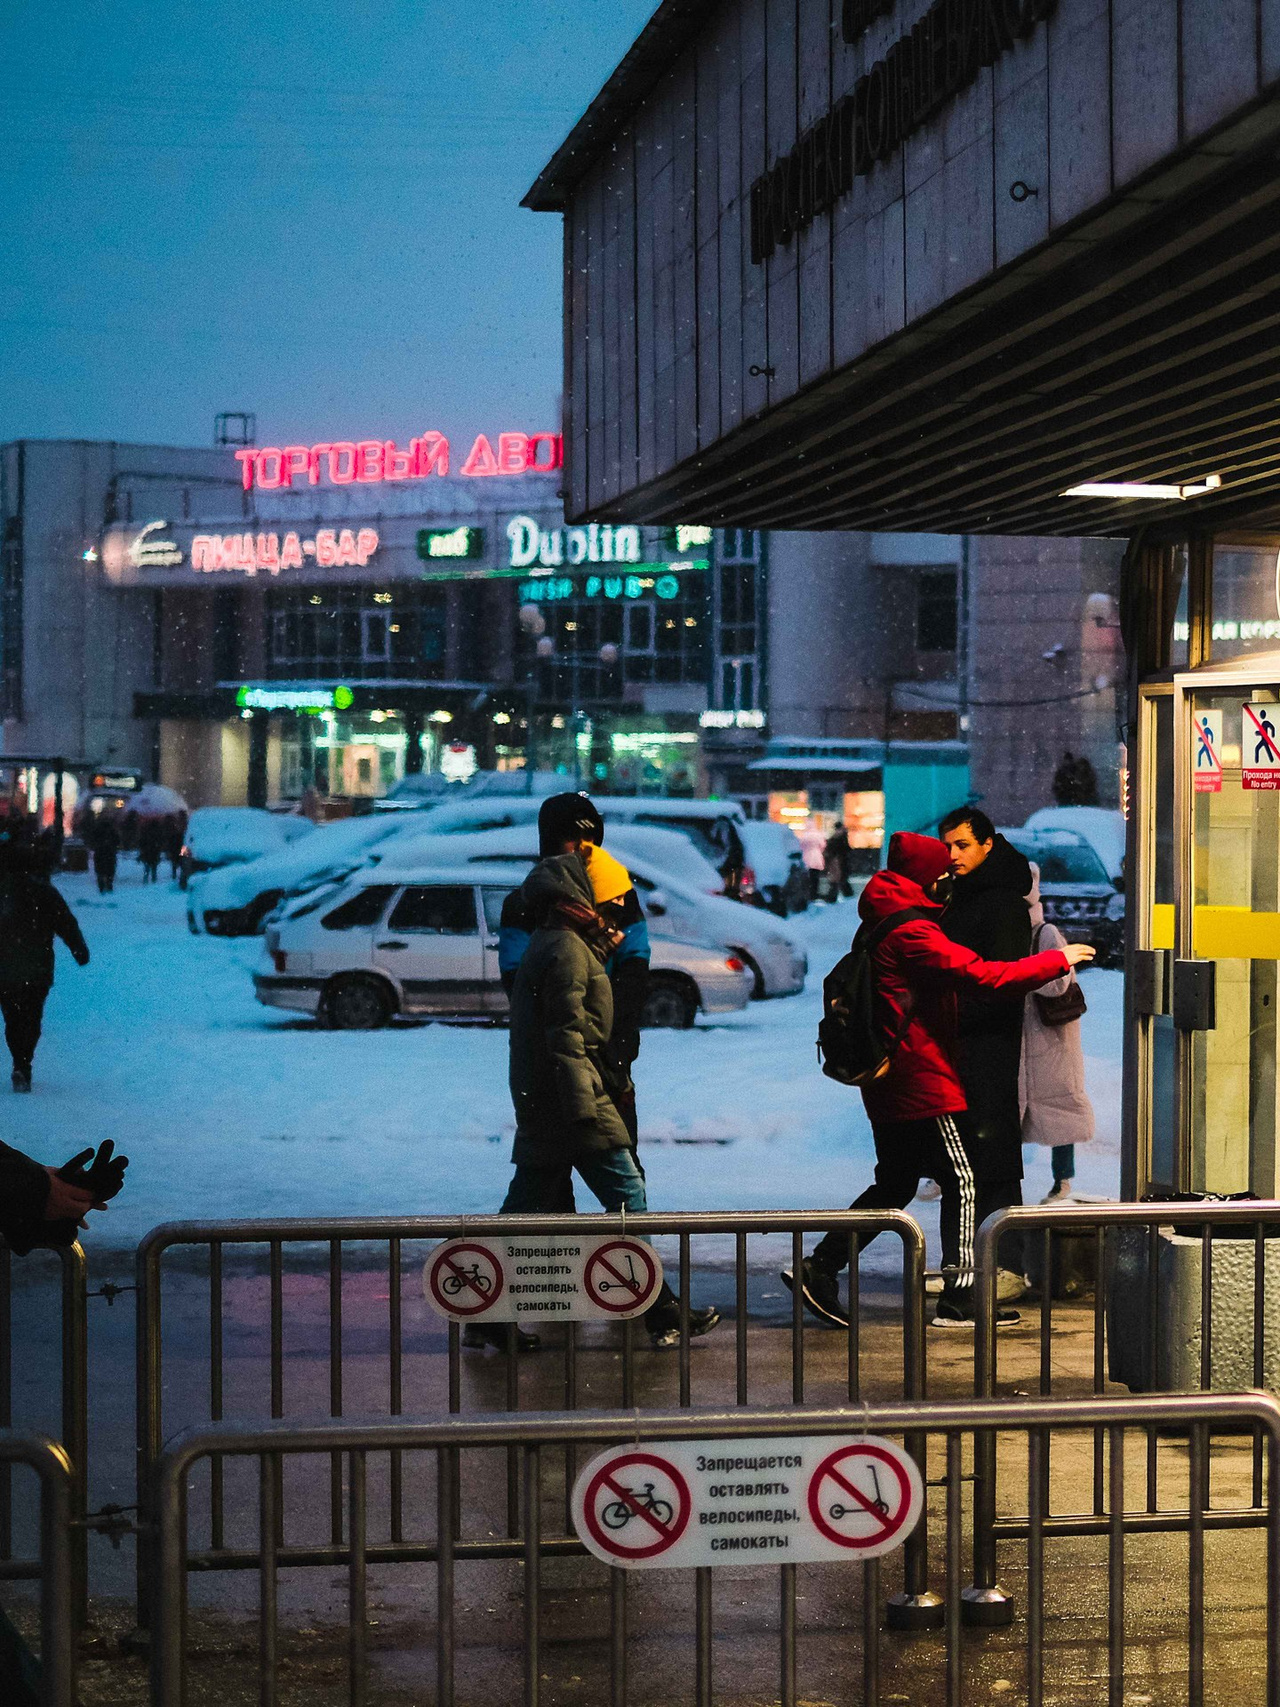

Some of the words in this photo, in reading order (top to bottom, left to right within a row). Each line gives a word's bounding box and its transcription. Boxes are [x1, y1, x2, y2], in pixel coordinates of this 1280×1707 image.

[235, 430, 449, 490] ТОРГОВЫЙ
[460, 431, 563, 477] ДВО
[506, 514, 641, 567] Dublin
[191, 527, 379, 577] ПИЦЦА-БАР
[1242, 770, 1272, 781] Прохода
[1251, 780, 1260, 788] No
[1261, 780, 1277, 790] entry
[507, 1246, 581, 1258] Запрещается
[516, 1265, 571, 1275] оставлять
[509, 1283, 579, 1294] велосипеды,
[516, 1300, 571, 1311] самокаты
[696, 1454, 802, 1471] Запрещается
[709, 1482, 789, 1498] оставлять
[699, 1509, 801, 1525] велосипеды,
[711, 1534, 789, 1550] самокаты
